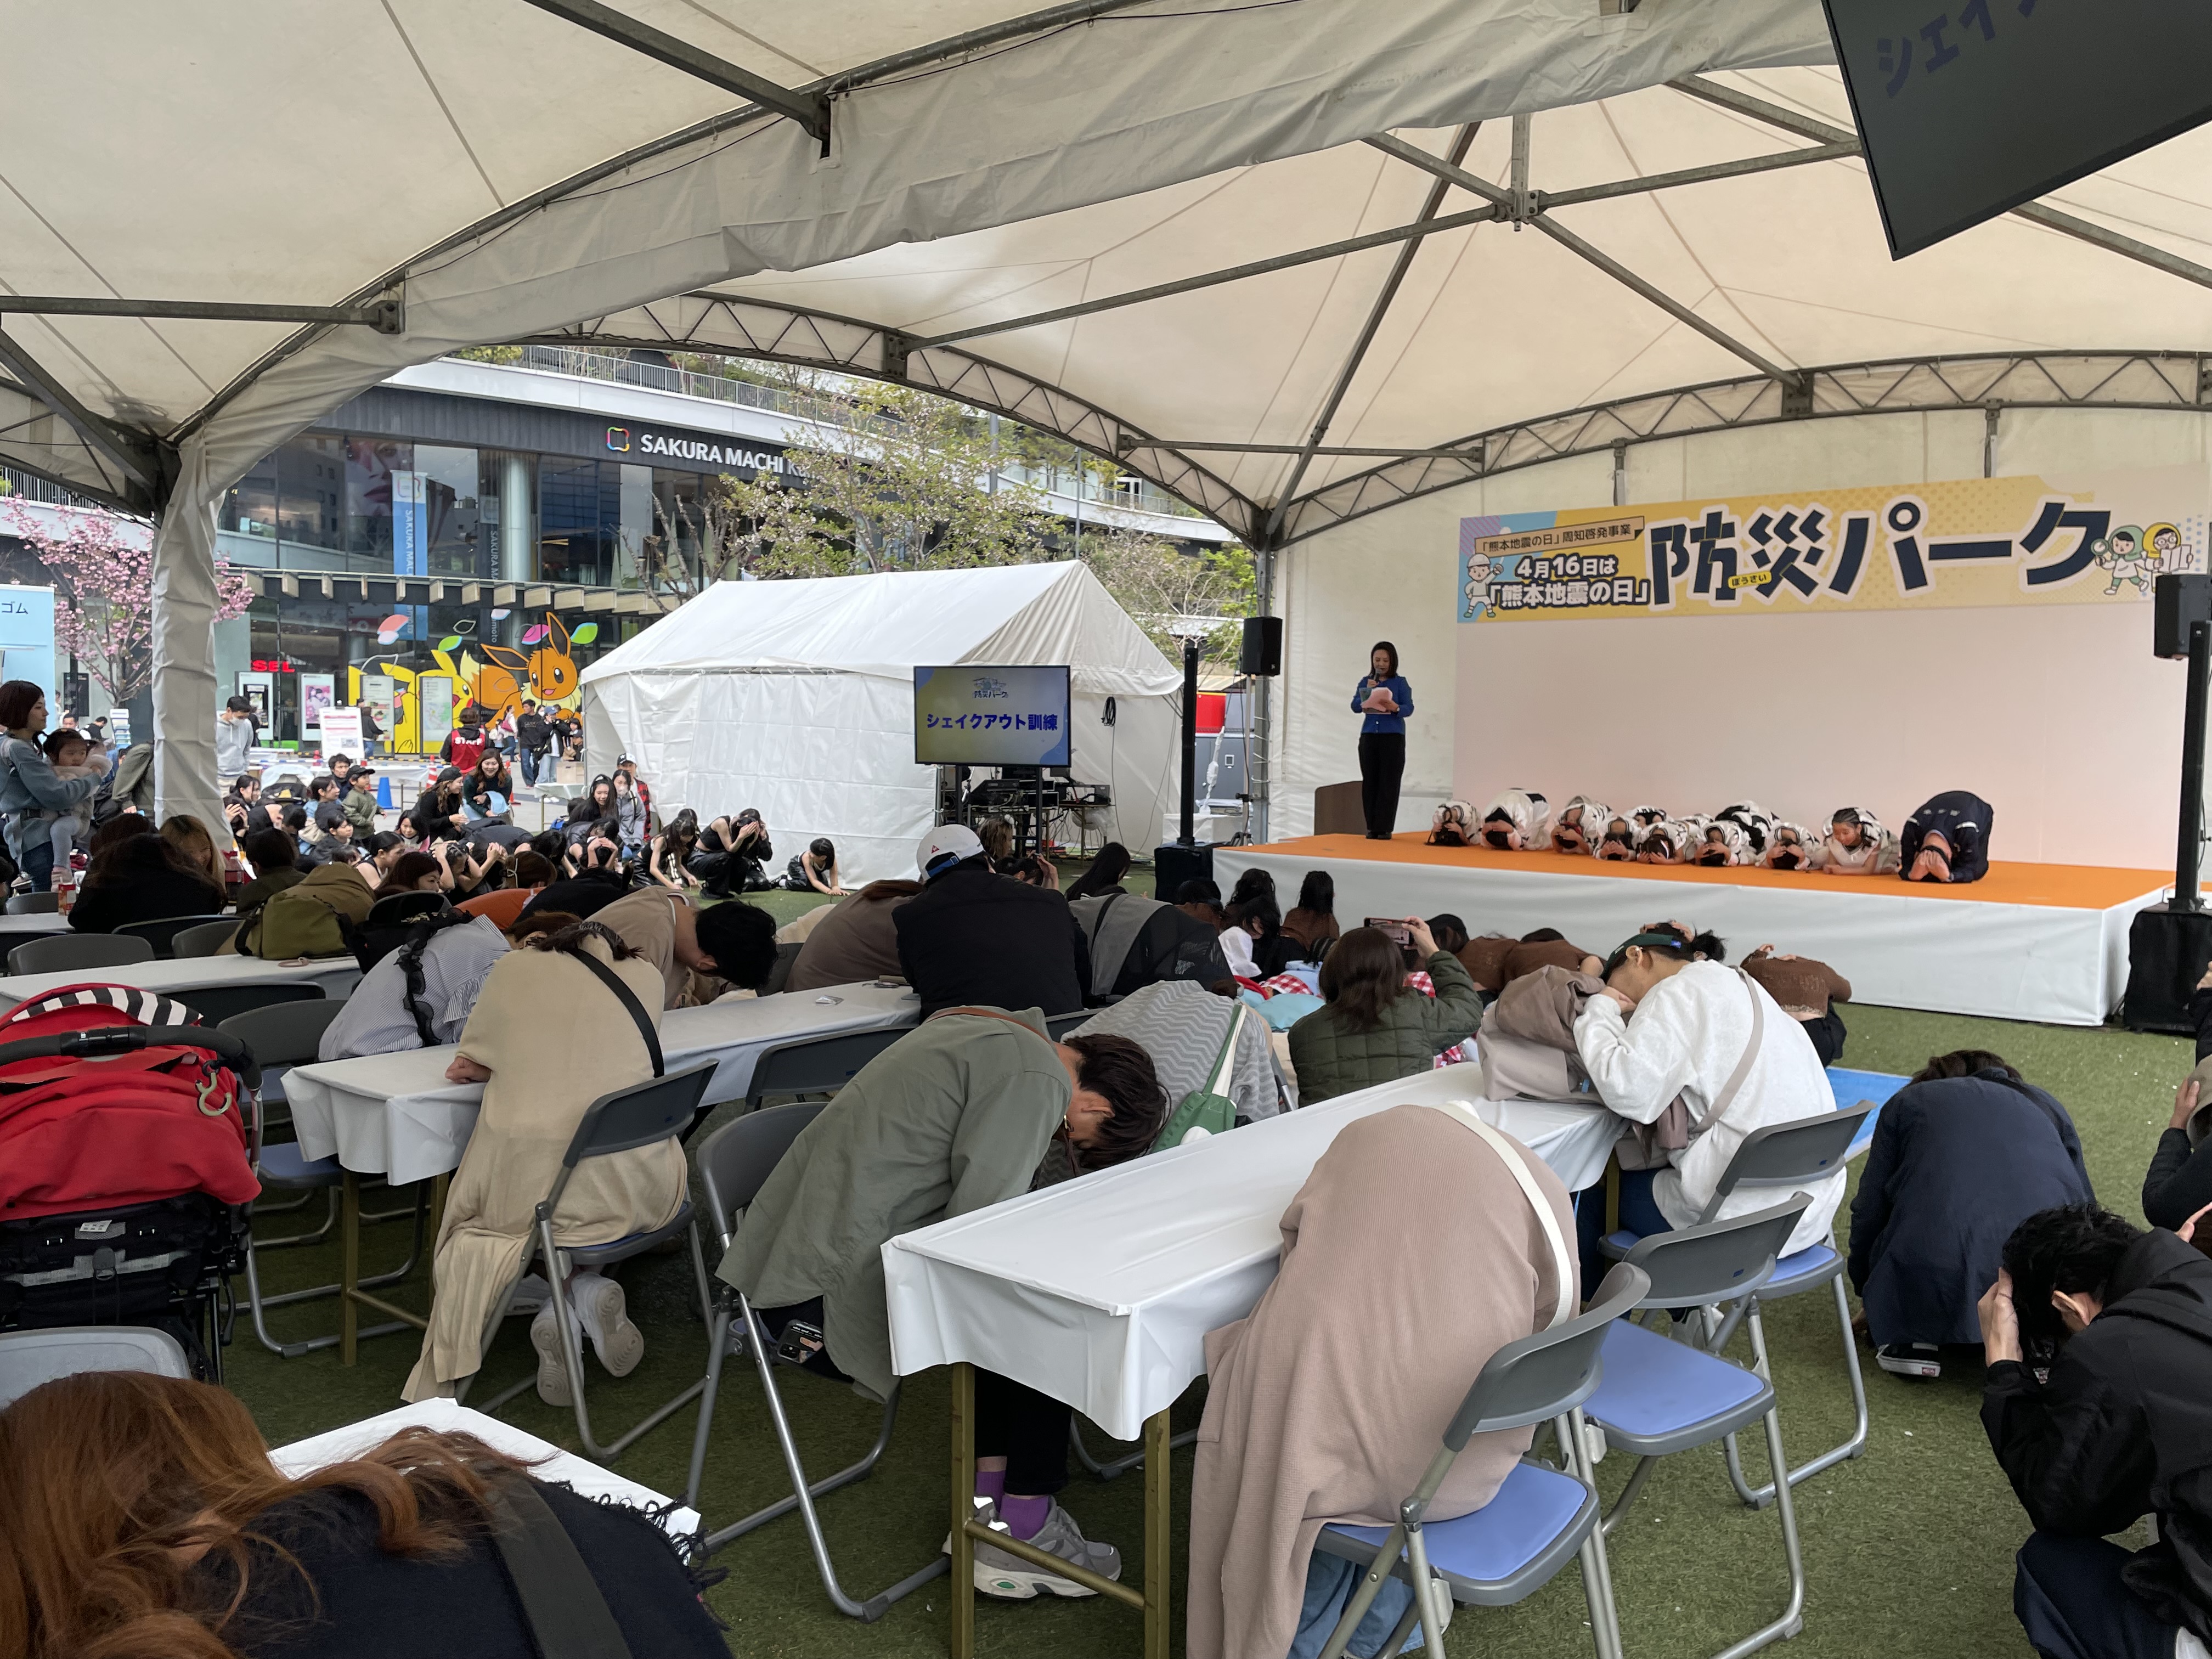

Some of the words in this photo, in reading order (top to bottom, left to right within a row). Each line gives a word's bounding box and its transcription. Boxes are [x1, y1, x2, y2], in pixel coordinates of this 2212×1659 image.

[1877, 0, 2038, 98] シェイ
[640, 433, 723, 464] SAKURA
[725, 447, 783, 473] MACHI
[405, 510, 414, 549] SAKURA
[1482, 523, 1632, 552] 「熊本地震の日」周知啓発事業
[405, 551, 414, 575] MAC
[490, 530, 499, 567] SAKURA
[1650, 501, 2112, 605] 防災パーク
[1516, 555, 1616, 579] 4月16日は
[1731, 573, 1767, 586] ぼうさい
[2, 601, 29, 614] ゴム
[1489, 579, 1649, 608] 「熊本地震の日」
[251, 659, 295, 673] SEL
[927, 713, 1058, 731] シェイクアウト訓練
